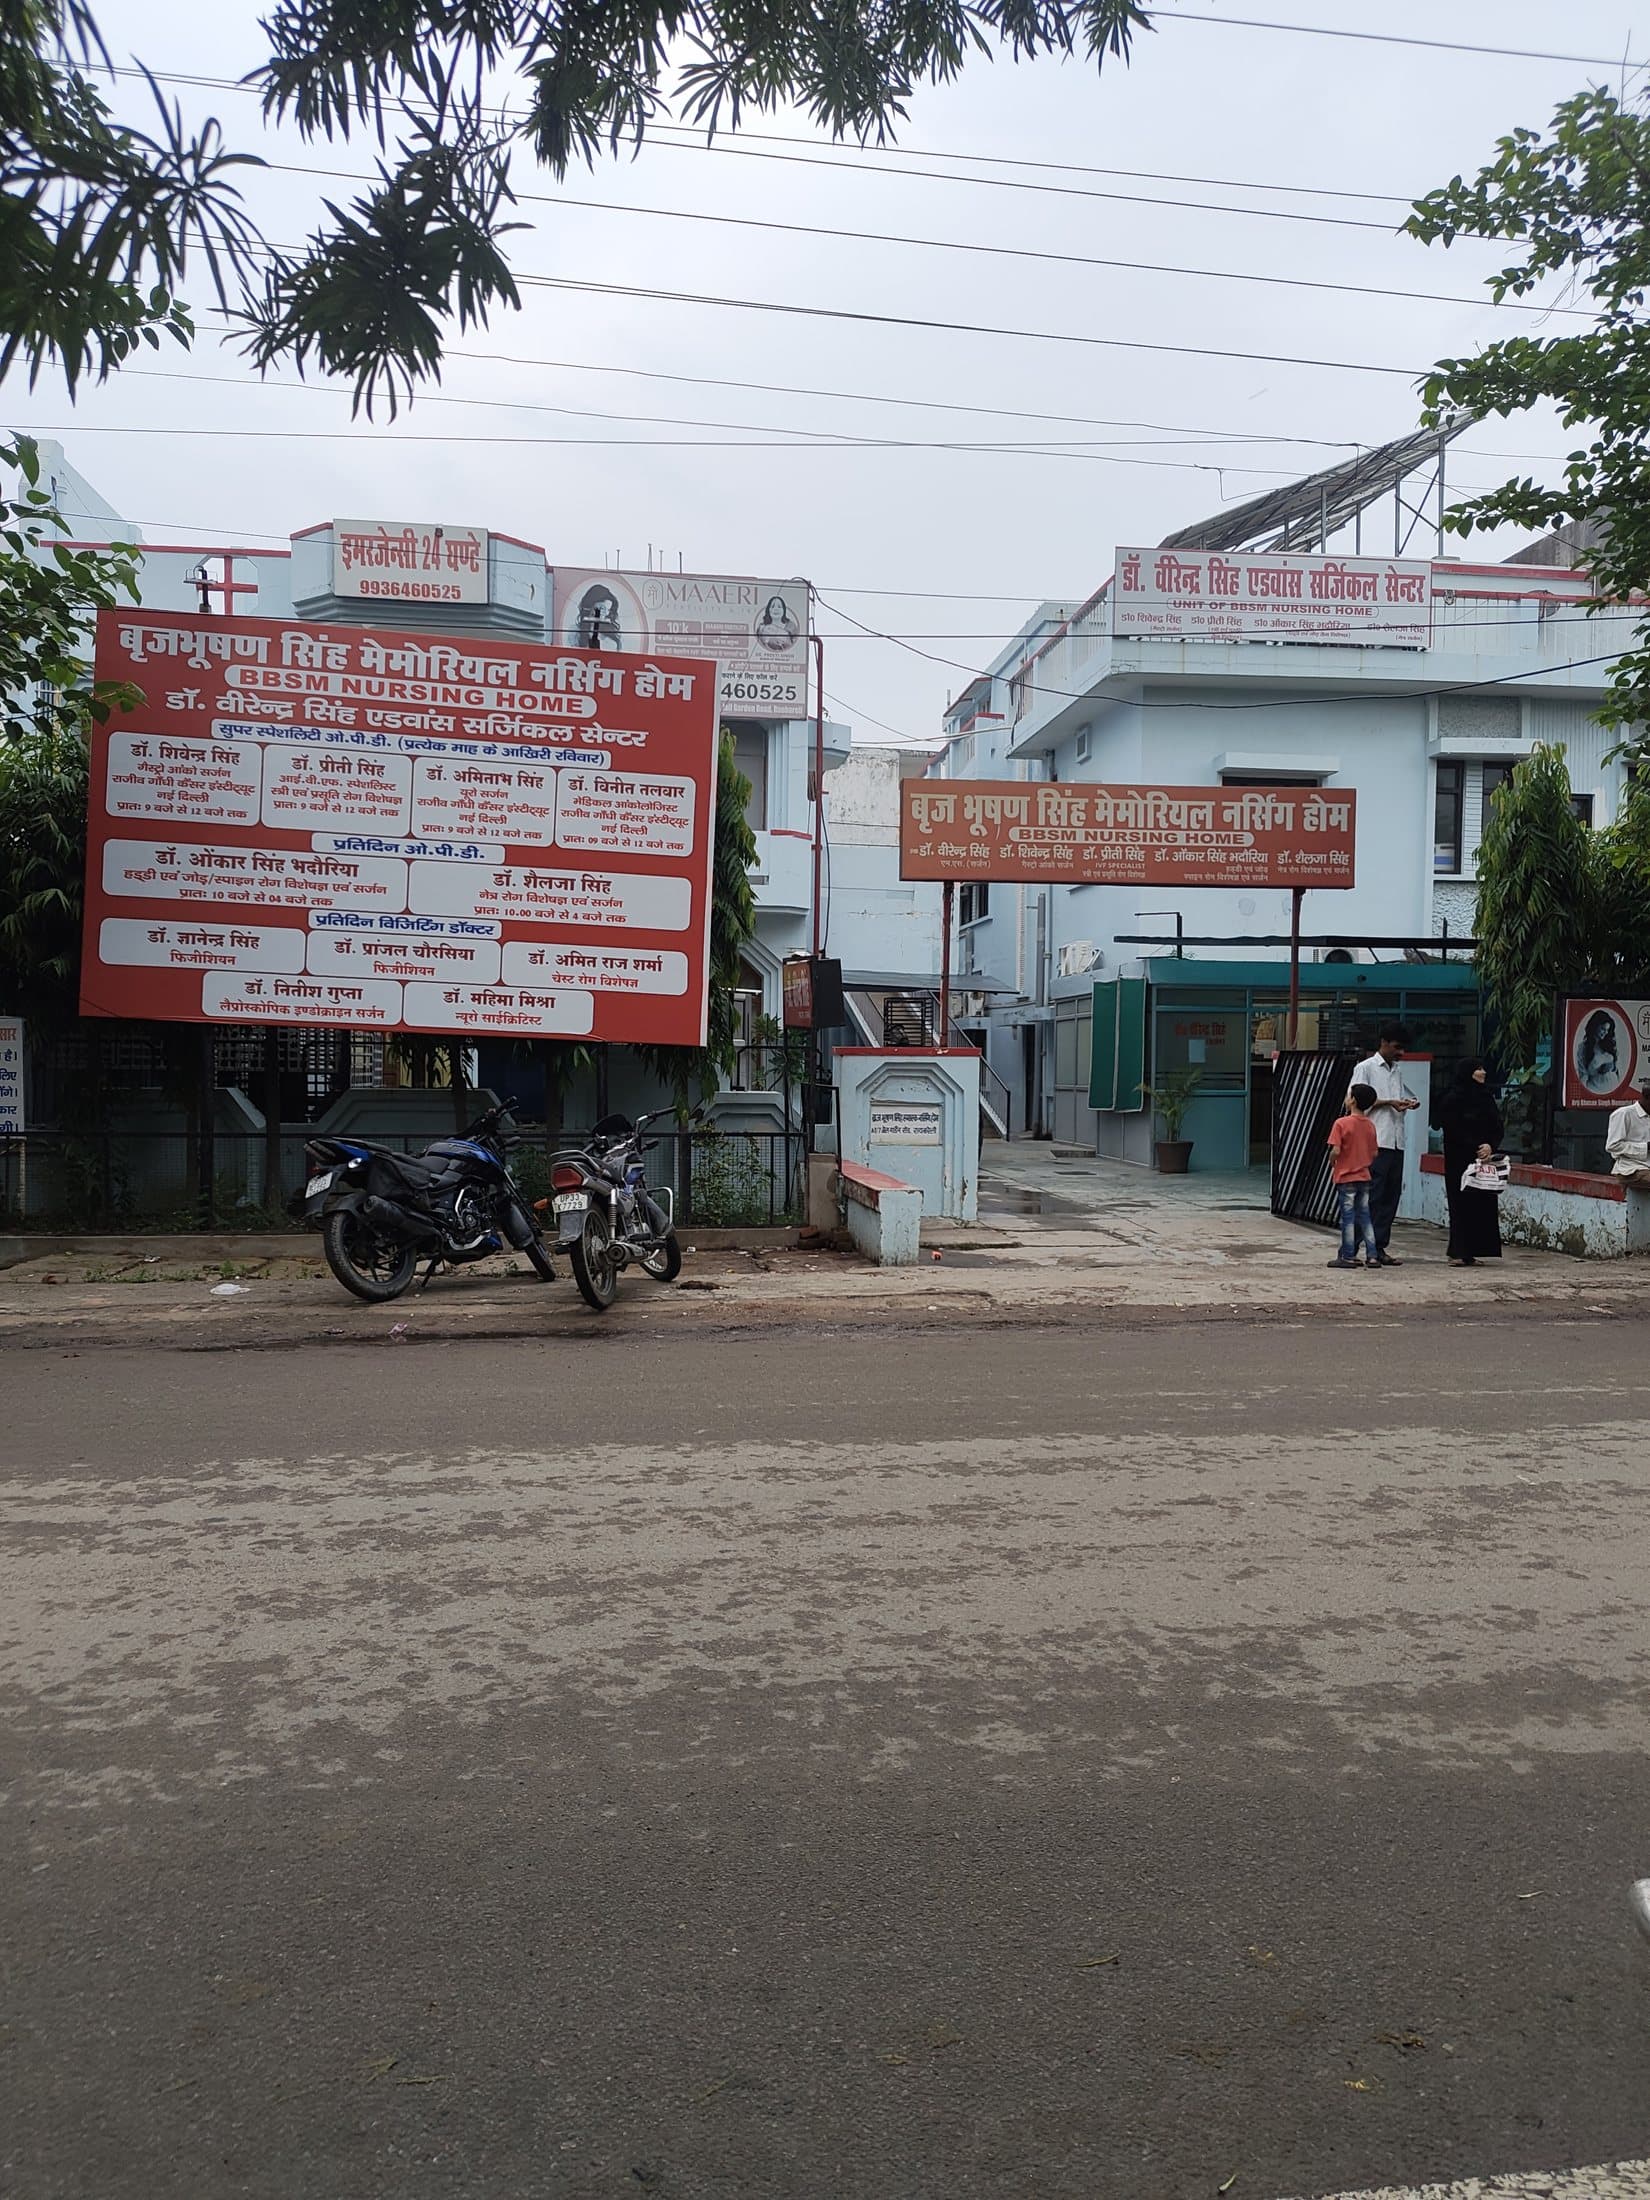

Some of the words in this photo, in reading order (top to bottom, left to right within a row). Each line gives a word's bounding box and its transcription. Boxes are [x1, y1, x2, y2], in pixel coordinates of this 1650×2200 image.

[423, 532, 444, 570] 24
[445, 531, 481, 573] घण्टे
[1121, 553, 1145, 592] डॉ.
[1154, 555, 1201, 595] वीरेन्द्र
[1208, 557, 1241, 595] सिंह
[1247, 560, 1303, 598] एडवांस
[1309, 562, 1379, 601] सर्जिकल
[1385, 565, 1425, 602] सेन्टर
[360, 580, 461, 600] 9936460525
[666, 582, 759, 605] MAAERI
[1173, 600, 1204, 609] UNIT
[1208, 602, 1227, 610] OF
[1230, 603, 1267, 612] BBSM
[1271, 604, 1334, 614] NURSING
[1335, 606, 1373, 616] HOME
[118, 624, 272, 670] बृजभूषण
[281, 631, 352, 671] सिंह
[359, 638, 522, 687] मेमोरियल
[529, 656, 626, 696] नर्सिंग
[633, 663, 696, 701] होम
[239, 668, 329, 692] BBSM
[341, 678, 485, 706] NURSING
[496, 692, 584, 714] HOME
[165, 687, 206, 710] डॉ.
[216, 690, 296, 720] वीरेन्द्र
[303, 697, 359, 725] सिंह
[365, 709, 457, 732] एडवांस
[462, 714, 575, 742] सर्जिकल
[580, 722, 649, 747] सेन्टर
[130, 740, 152, 758] डॉ.
[159, 741, 207, 763] शिवेन्द्र
[211, 745, 240, 766] सिंह
[219, 723, 253, 739] सुपर
[256, 725, 321, 742] स्पेशलिटी
[398, 735, 448, 752] (प्रत्येक
[451, 743, 477, 756] माह
[482, 743, 497, 756] के
[501, 746, 551, 760] आखिरी
[555, 749, 605, 766] रविवार)
[200, 766, 231, 778] सर्जन
[291, 754, 312, 771] डॉ.
[319, 754, 352, 775] प्रीती
[357, 758, 386, 778] सिंह
[346, 778, 396, 791] स्पेशलिस्ट
[426, 765, 447, 781] डॉ.
[453, 767, 513, 787] अमिताभ
[517, 770, 545, 790] सिंह
[567, 775, 588, 791] डॉ.
[594, 776, 636, 795] विनीत
[639, 783, 686, 799] तलवार
[910, 792, 957, 834] बृज
[963, 794, 1031, 837] भूषण
[1037, 788, 1088, 827] सिंह
[1094, 789, 1215, 830] मेमोरियल
[1222, 793, 1296, 831] नर्सिंग
[1302, 793, 1351, 832] होम
[333, 836, 400, 854] प्रतिदिन
[1018, 829, 1077, 841] BBSM
[1084, 830, 1178, 843] NURSING
[1185, 833, 1245, 845] HOME
[155, 846, 181, 866] डॉ.
[189, 847, 247, 870] ओंकार
[252, 851, 286, 874] सिंह
[291, 855, 360, 877] भदौरिया
[918, 843, 934, 857] डॉ.
[937, 842, 966, 859] वीरेन्द्र
[970, 843, 990, 858] सिंह
[999, 845, 1014, 858] डॉ.
[1018, 844, 1050, 860] शिवेन्द्र
[1053, 845, 1073, 860] सिंह
[1082, 847, 1098, 861] डॉ.
[1101, 847, 1122, 862] प्रीती
[1125, 847, 1145, 862] सिंह
[1154, 848, 1169, 862] डॉ.
[1172, 849, 1204, 863] ओंकार
[1207, 848, 1226, 863] सिंह
[1230, 849, 1268, 863] भदौरिया
[1277, 850, 1292, 864] डॉ.
[1295, 850, 1327, 865] शैलजा
[1330, 850, 1350, 866] सिंह
[492, 869, 516, 887] डॉ.
[523, 869, 576, 891] शैलजा
[581, 873, 612, 894] सिंह
[479, 888, 498, 901] नेत्र
[501, 889, 523, 902] रोग
[526, 890, 568, 906] विशेषज्ञ
[571, 896, 588, 907] एवं
[591, 897, 623, 908] सर्जन
[315, 912, 374, 928] प्रतिदिन
[379, 916, 445, 932] विजिटिंग
[448, 920, 496, 936] डॉक्टर
[504, 908, 532, 917] 10.00
[535, 907, 555, 920] बजे
[559, 909, 569, 921] से
[572, 912, 579, 921] 4
[582, 911, 602, 923] बजे
[606, 913, 628, 923] तक
[147, 926, 171, 944] डॉ.
[177, 928, 225, 948] ज्ञानेन्द्र
[230, 930, 260, 950] सिंह
[170, 949, 236, 965] फिजीशियन
[334, 938, 356, 954] डॉ.
[362, 939, 408, 957] प्रांजल
[413, 941, 475, 961] चौरसिया
[528, 949, 549, 965] डॉ.
[555, 951, 598, 968] अमित
[602, 957, 628, 970] राज
[633, 955, 663, 972] शर्मा
[373, 960, 436, 977] फिजीशियन
[245, 978, 267, 995] डॉ.
[273, 979, 323, 998] नितीश
[327, 986, 363, 1004] गुप्ता
[552, 972, 575, 984] चेस्ट
[578, 973, 597, 986] रोग
[600, 973, 640, 989] विशेषज्ञ
[219, 998, 291, 1015] लैप्रोस्कोपिक
[294, 1003, 352, 1018] इण्डोक्राइन
[355, 1005, 386, 1019] सर्जन
[443, 988, 464, 1004] डॉ.
[470, 989, 514, 1007] महिमा
[519, 990, 556, 1009] मिश्रा
[455, 1009, 478, 1025] न्यूरो
